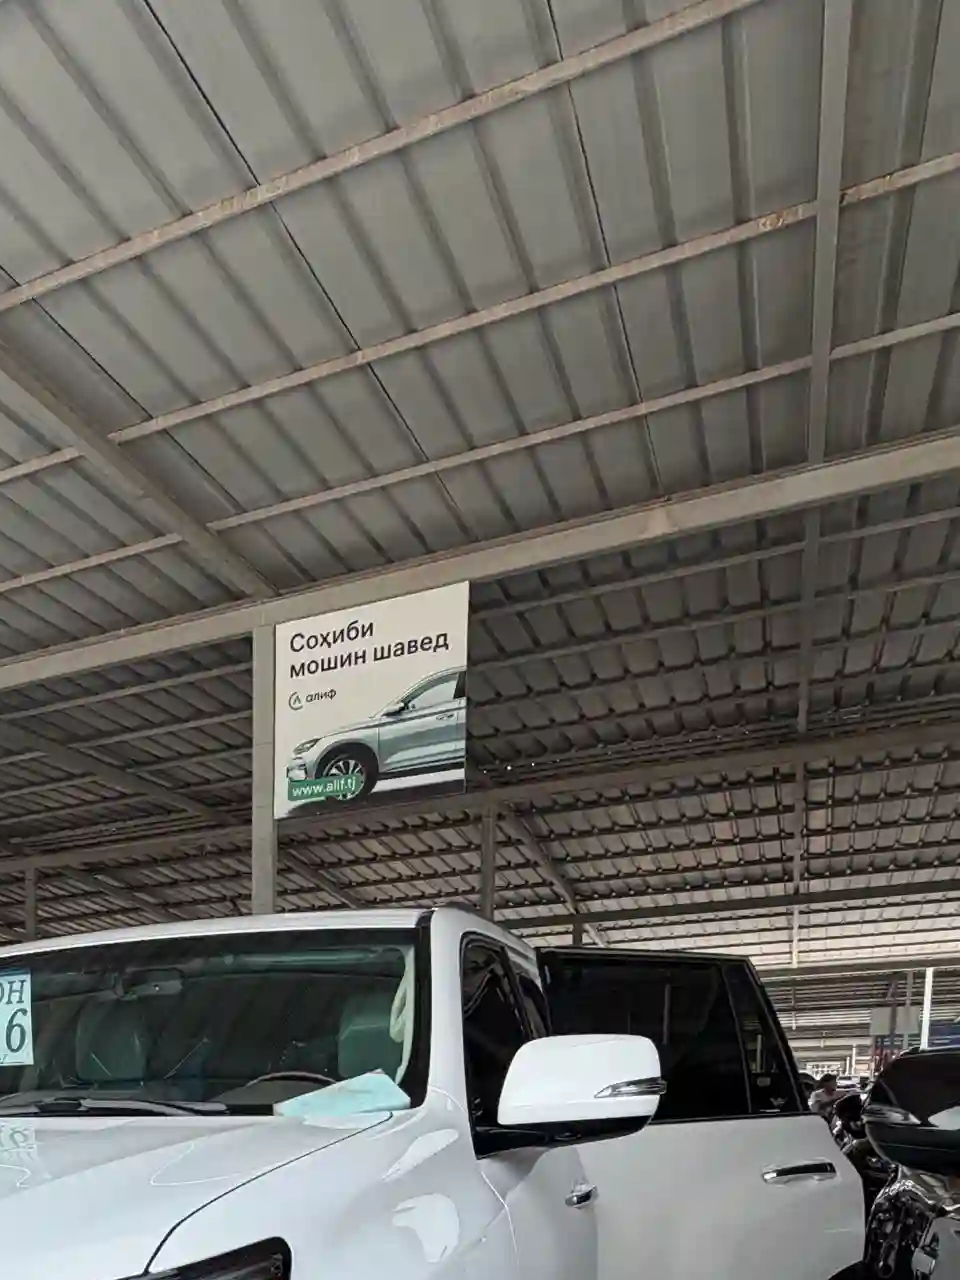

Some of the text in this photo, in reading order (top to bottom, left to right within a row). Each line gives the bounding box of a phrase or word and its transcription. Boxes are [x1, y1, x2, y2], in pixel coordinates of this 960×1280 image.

[290, 620, 374, 653] Соҳиби
[290, 633, 450, 678] мошин шавед
[306, 689, 337, 703] алиф
[292, 776, 356, 797] www.alif.tj
